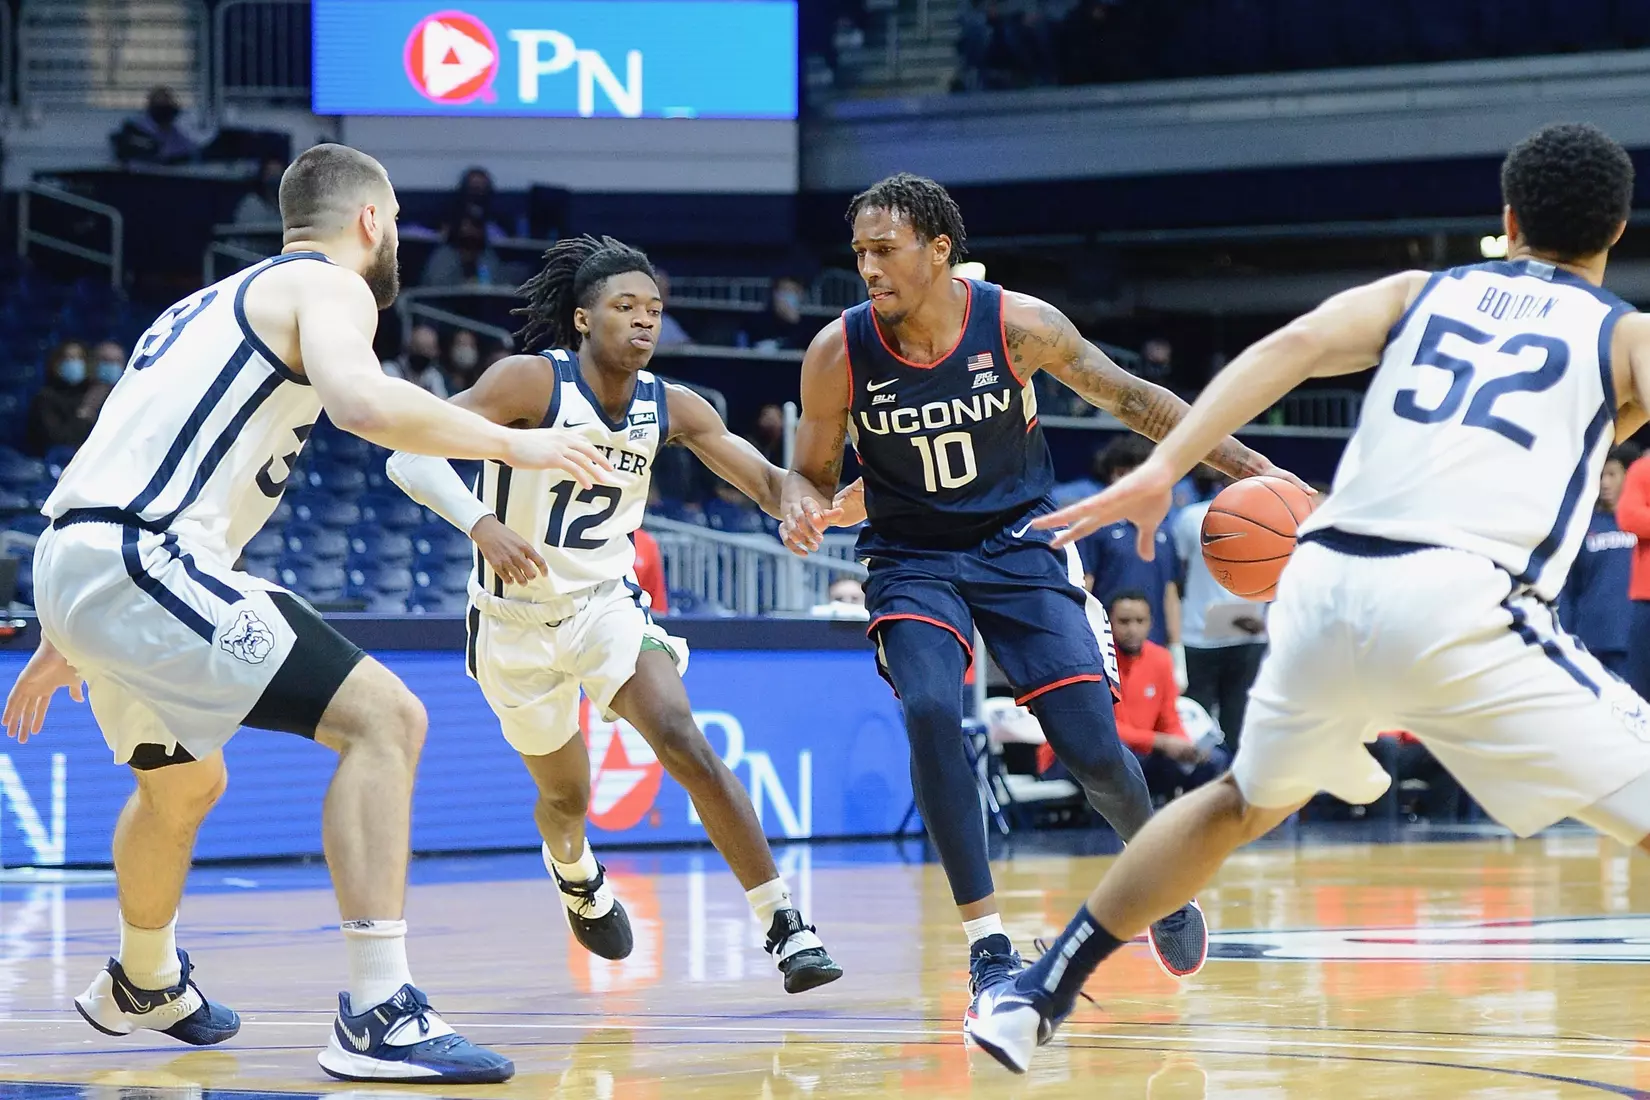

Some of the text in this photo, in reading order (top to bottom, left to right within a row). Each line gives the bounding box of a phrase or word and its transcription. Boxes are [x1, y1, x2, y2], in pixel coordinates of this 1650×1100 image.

[507, 29, 643, 118] PN
[860, 388, 1010, 435] UCONN
[874, 394, 896, 403] BLM
[1393, 313, 1571, 452] 52
[910, 431, 978, 492] 10
[544, 480, 622, 550] 12
